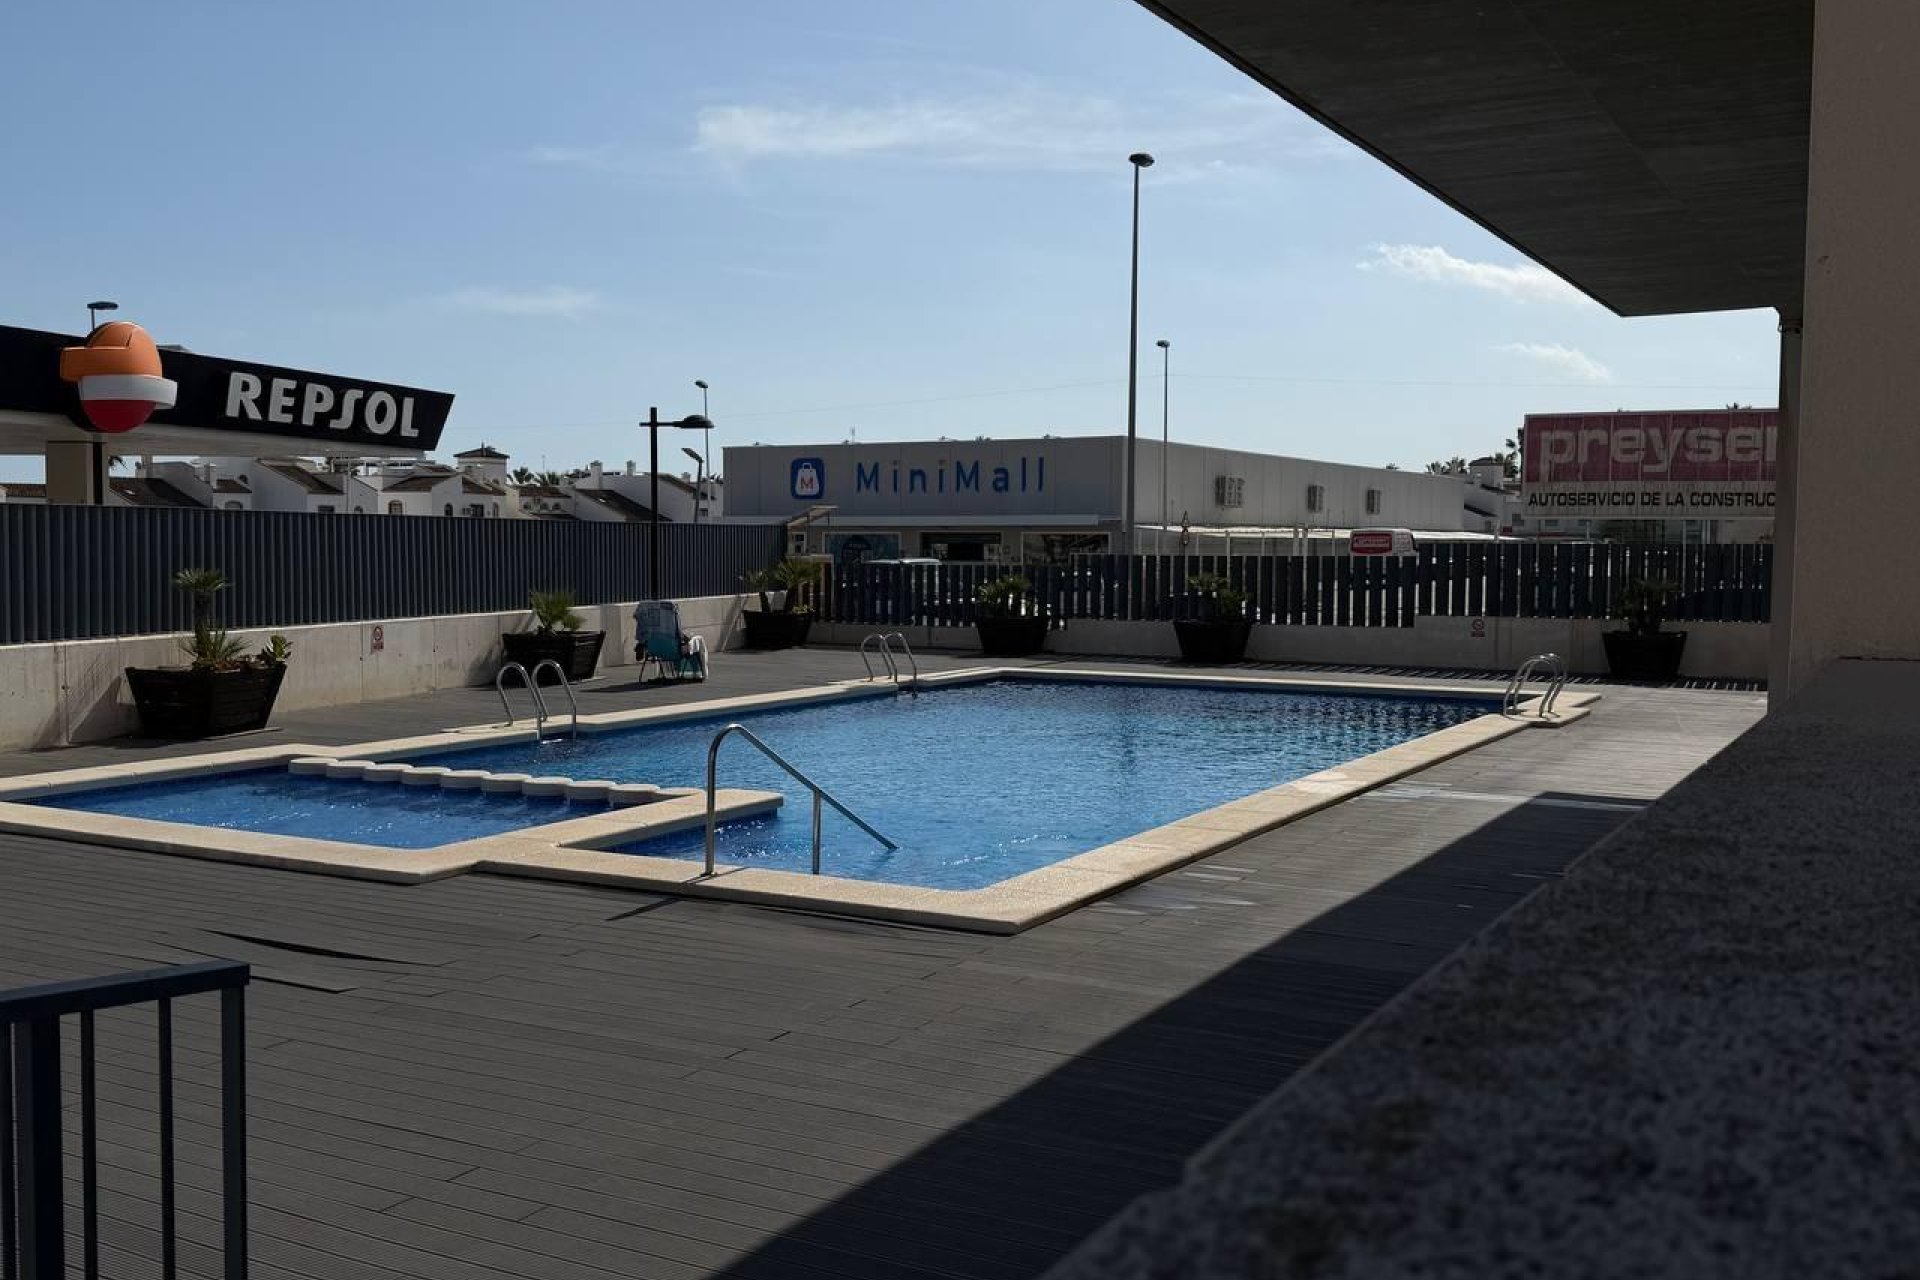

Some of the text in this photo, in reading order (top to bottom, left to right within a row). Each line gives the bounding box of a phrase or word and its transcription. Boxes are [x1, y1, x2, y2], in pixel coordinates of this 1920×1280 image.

[225, 371, 420, 437] REPSOL
[800, 477, 814, 490] M
[855, 456, 1045, 494] MiniMall
[1528, 492, 1636, 507] AUTOSERVICIO
[1640, 492, 1661, 507] DE
[1665, 492, 1686, 507] LA
